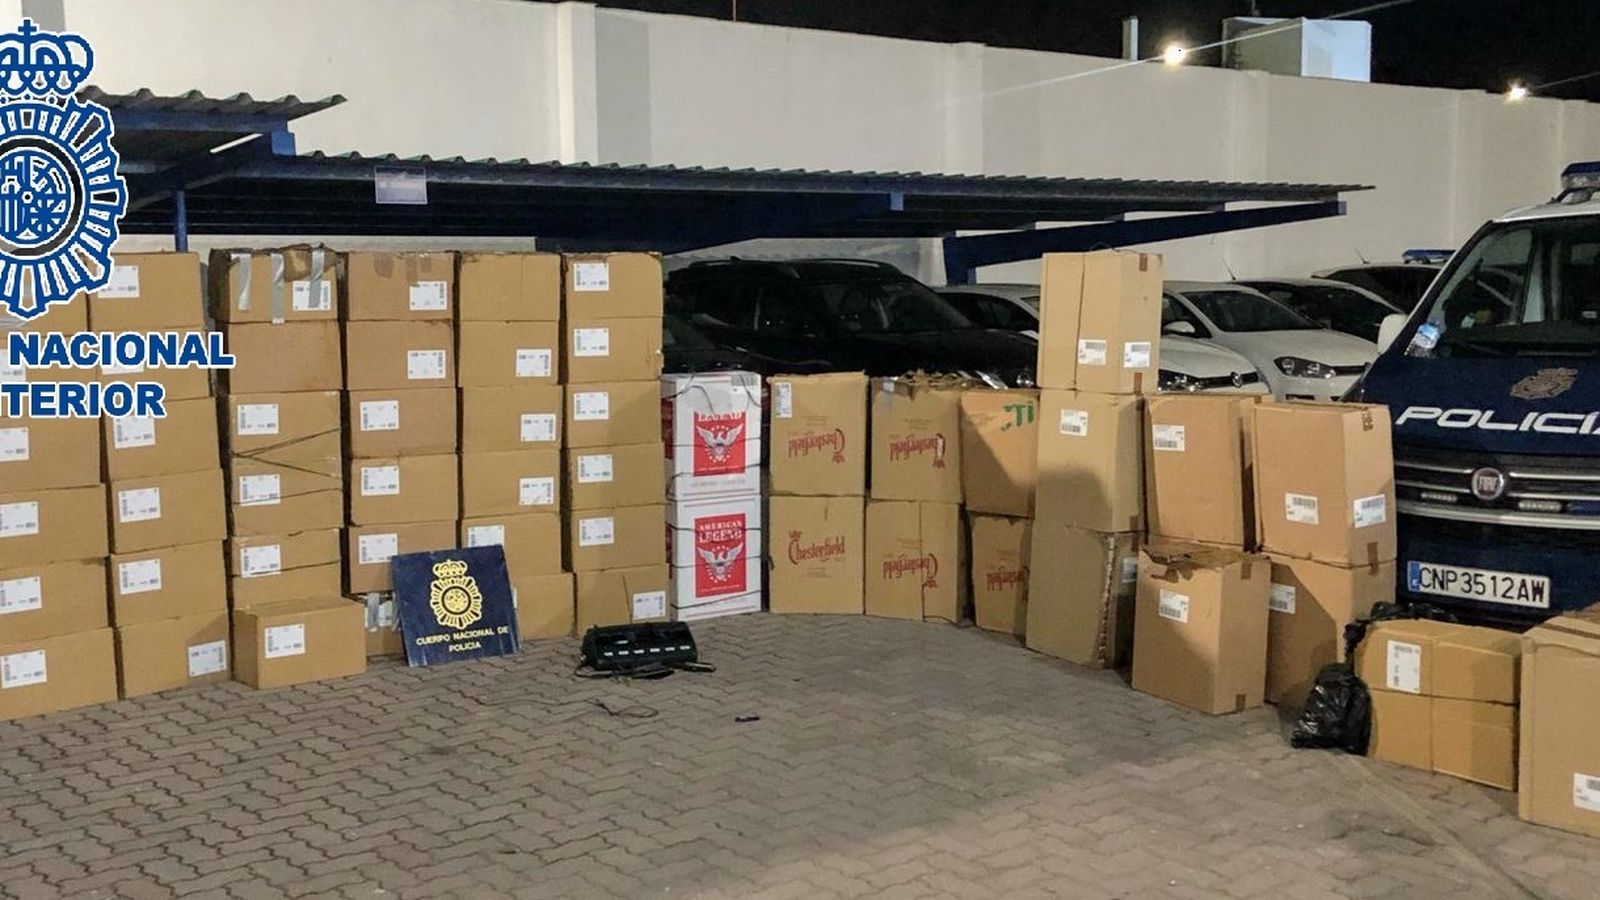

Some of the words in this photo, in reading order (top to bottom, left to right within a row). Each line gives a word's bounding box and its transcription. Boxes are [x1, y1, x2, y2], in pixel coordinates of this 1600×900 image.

[788, 428, 845, 459] Chesterfield
[889, 433, 946, 461] Chesterfield
[699, 528, 742, 544] LEGEND
[700, 520, 743, 531] AMERICAN
[788, 536, 845, 565] Chesterfield
[883, 553, 938, 579] Chesterfield
[416, 634, 450, 646] CUERPO
[453, 628, 495, 640] NACIONAL
[497, 625, 509, 634] DE
[448, 642, 481, 652] POLICIA
